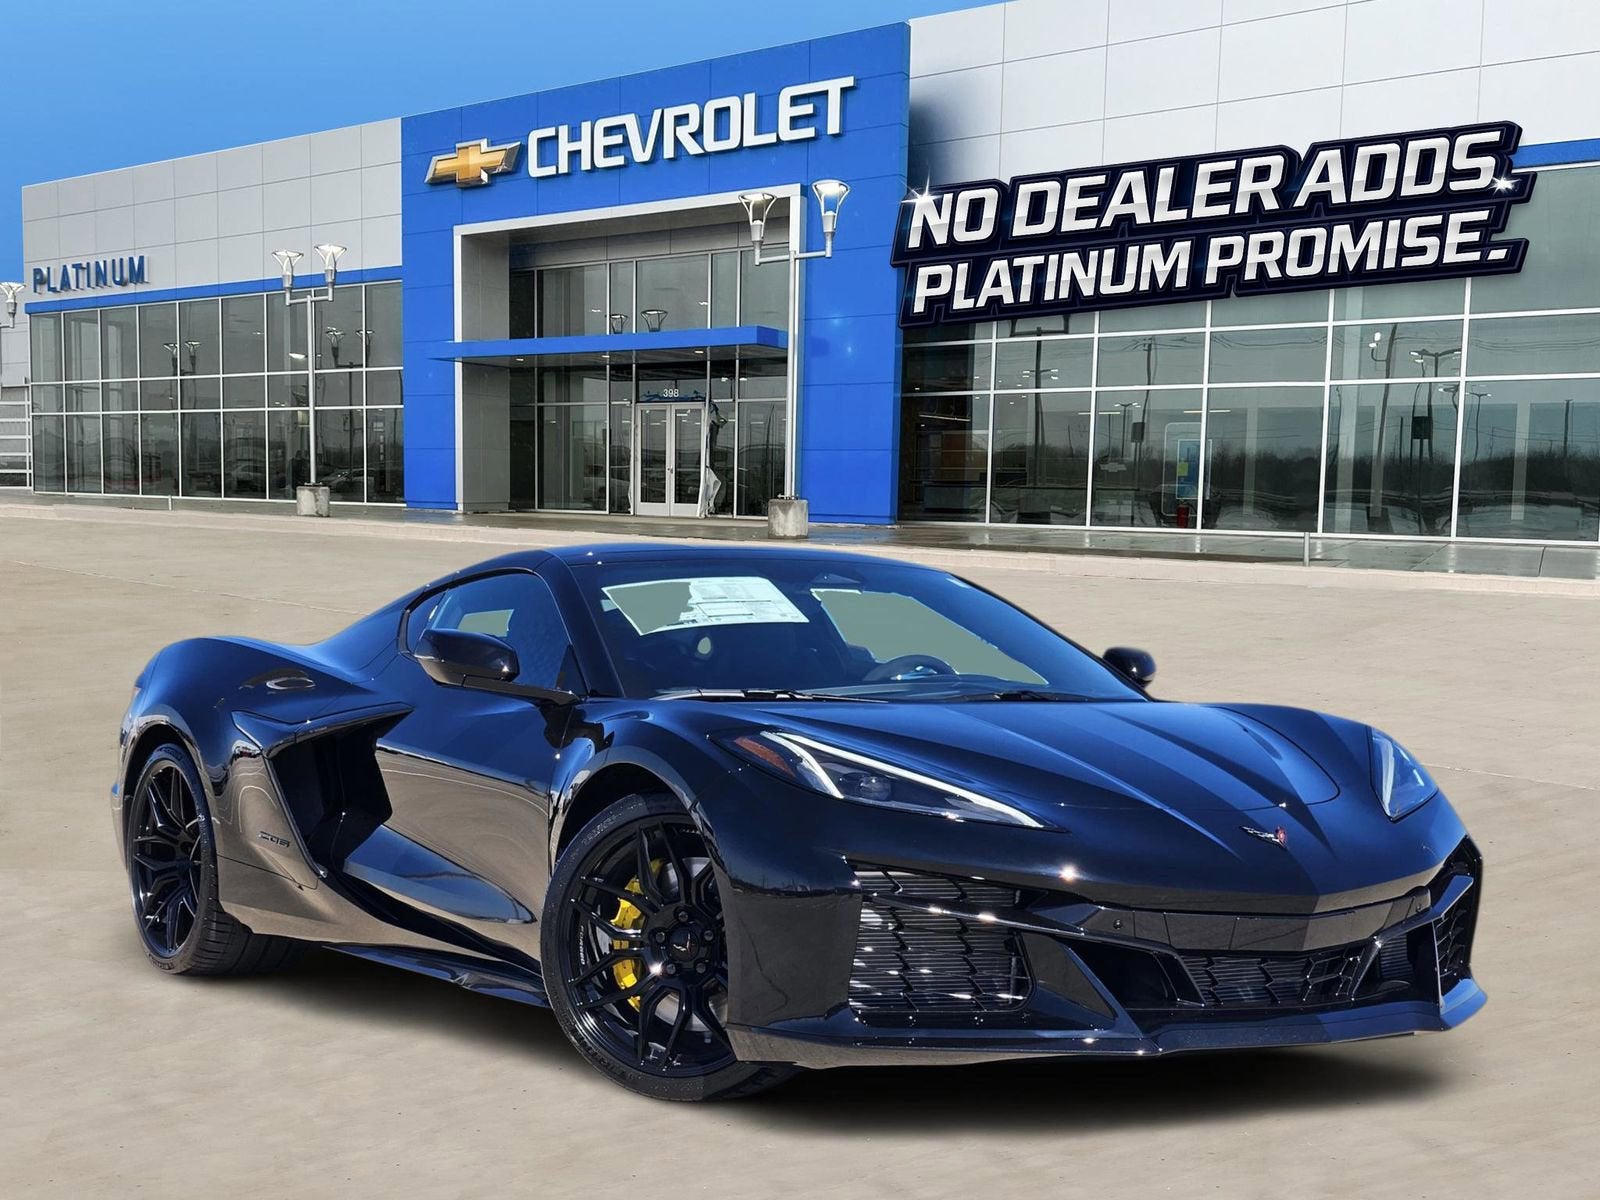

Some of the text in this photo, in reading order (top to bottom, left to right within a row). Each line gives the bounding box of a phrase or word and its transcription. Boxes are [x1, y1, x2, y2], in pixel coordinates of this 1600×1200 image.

[528, 76, 855, 178] CHEVROLET
[33, 256, 145, 293] PLATINUM
[663, 388, 680, 398] 398
